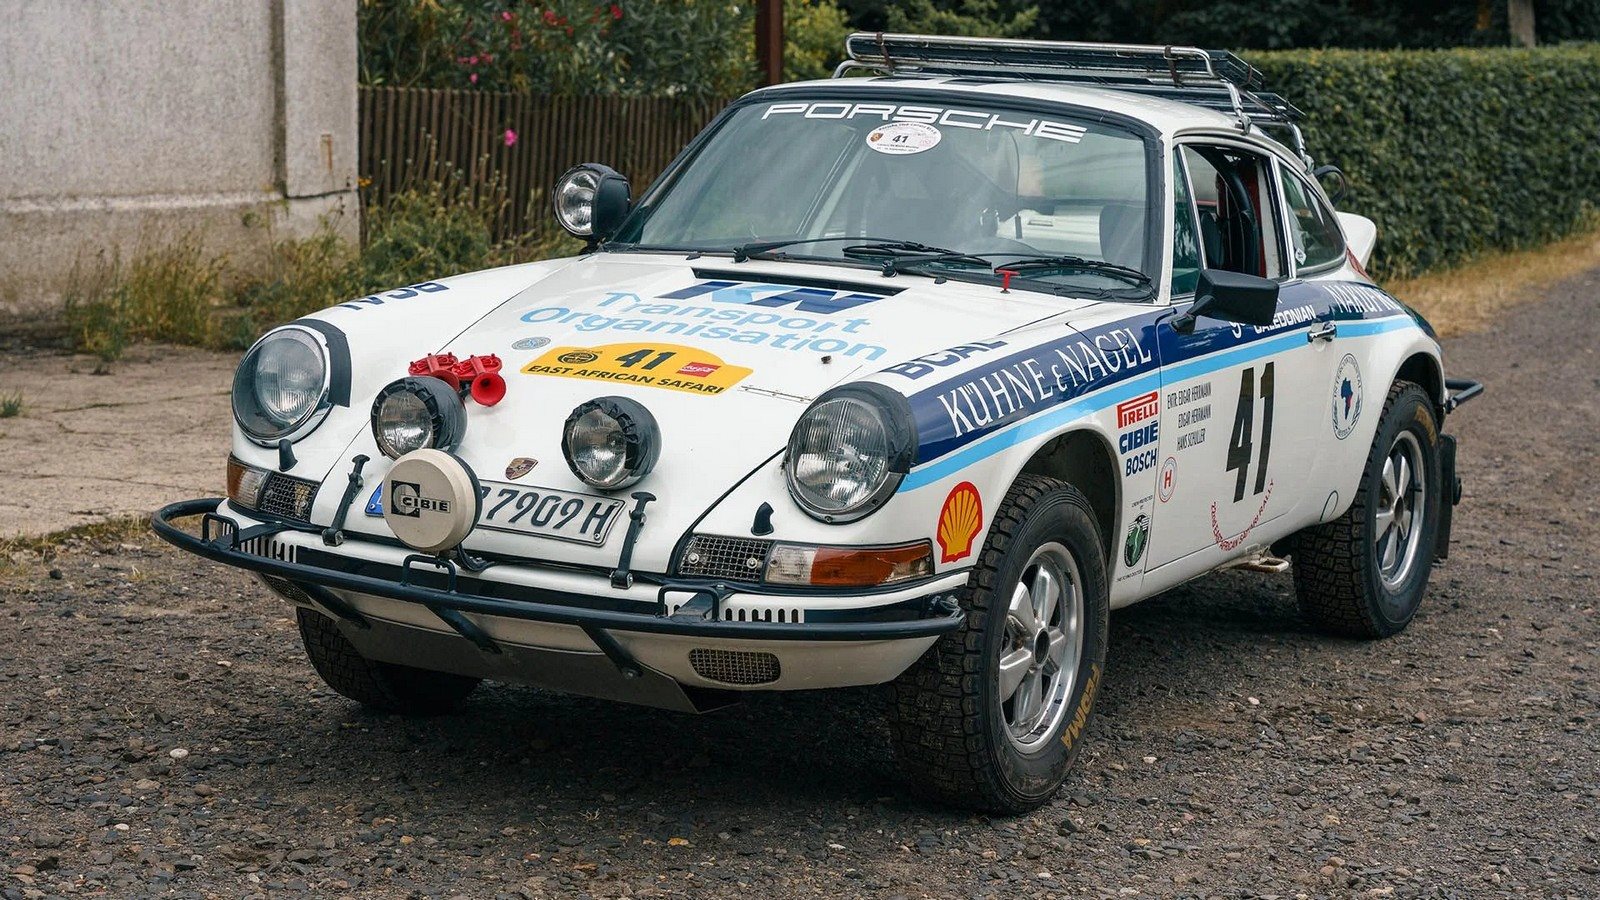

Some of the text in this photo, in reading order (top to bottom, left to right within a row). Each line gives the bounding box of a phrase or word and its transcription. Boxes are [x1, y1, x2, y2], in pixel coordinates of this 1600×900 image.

[761, 103, 1087, 144] PORSCHE
[892, 135, 909, 143] 41
[596, 292, 872, 335] Transport
[1254, 305, 1316, 334] EDONIAN
[519, 306, 888, 361] Organisation
[615, 349, 676, 370] 41
[887, 340, 1008, 380] BCAL
[527, 365, 724, 394] EAST AFRICAN SAFARI
[937, 358, 1053, 438] KÜHNE
[1055, 327, 1152, 383] NAGEL
[1116, 391, 1159, 429] PIRELLI
[1226, 362, 1275, 504] 41
[1126, 448, 1157, 477] BOSCH
[1164, 469, 1172, 489] H
[481, 486, 615, 535] 7909H
